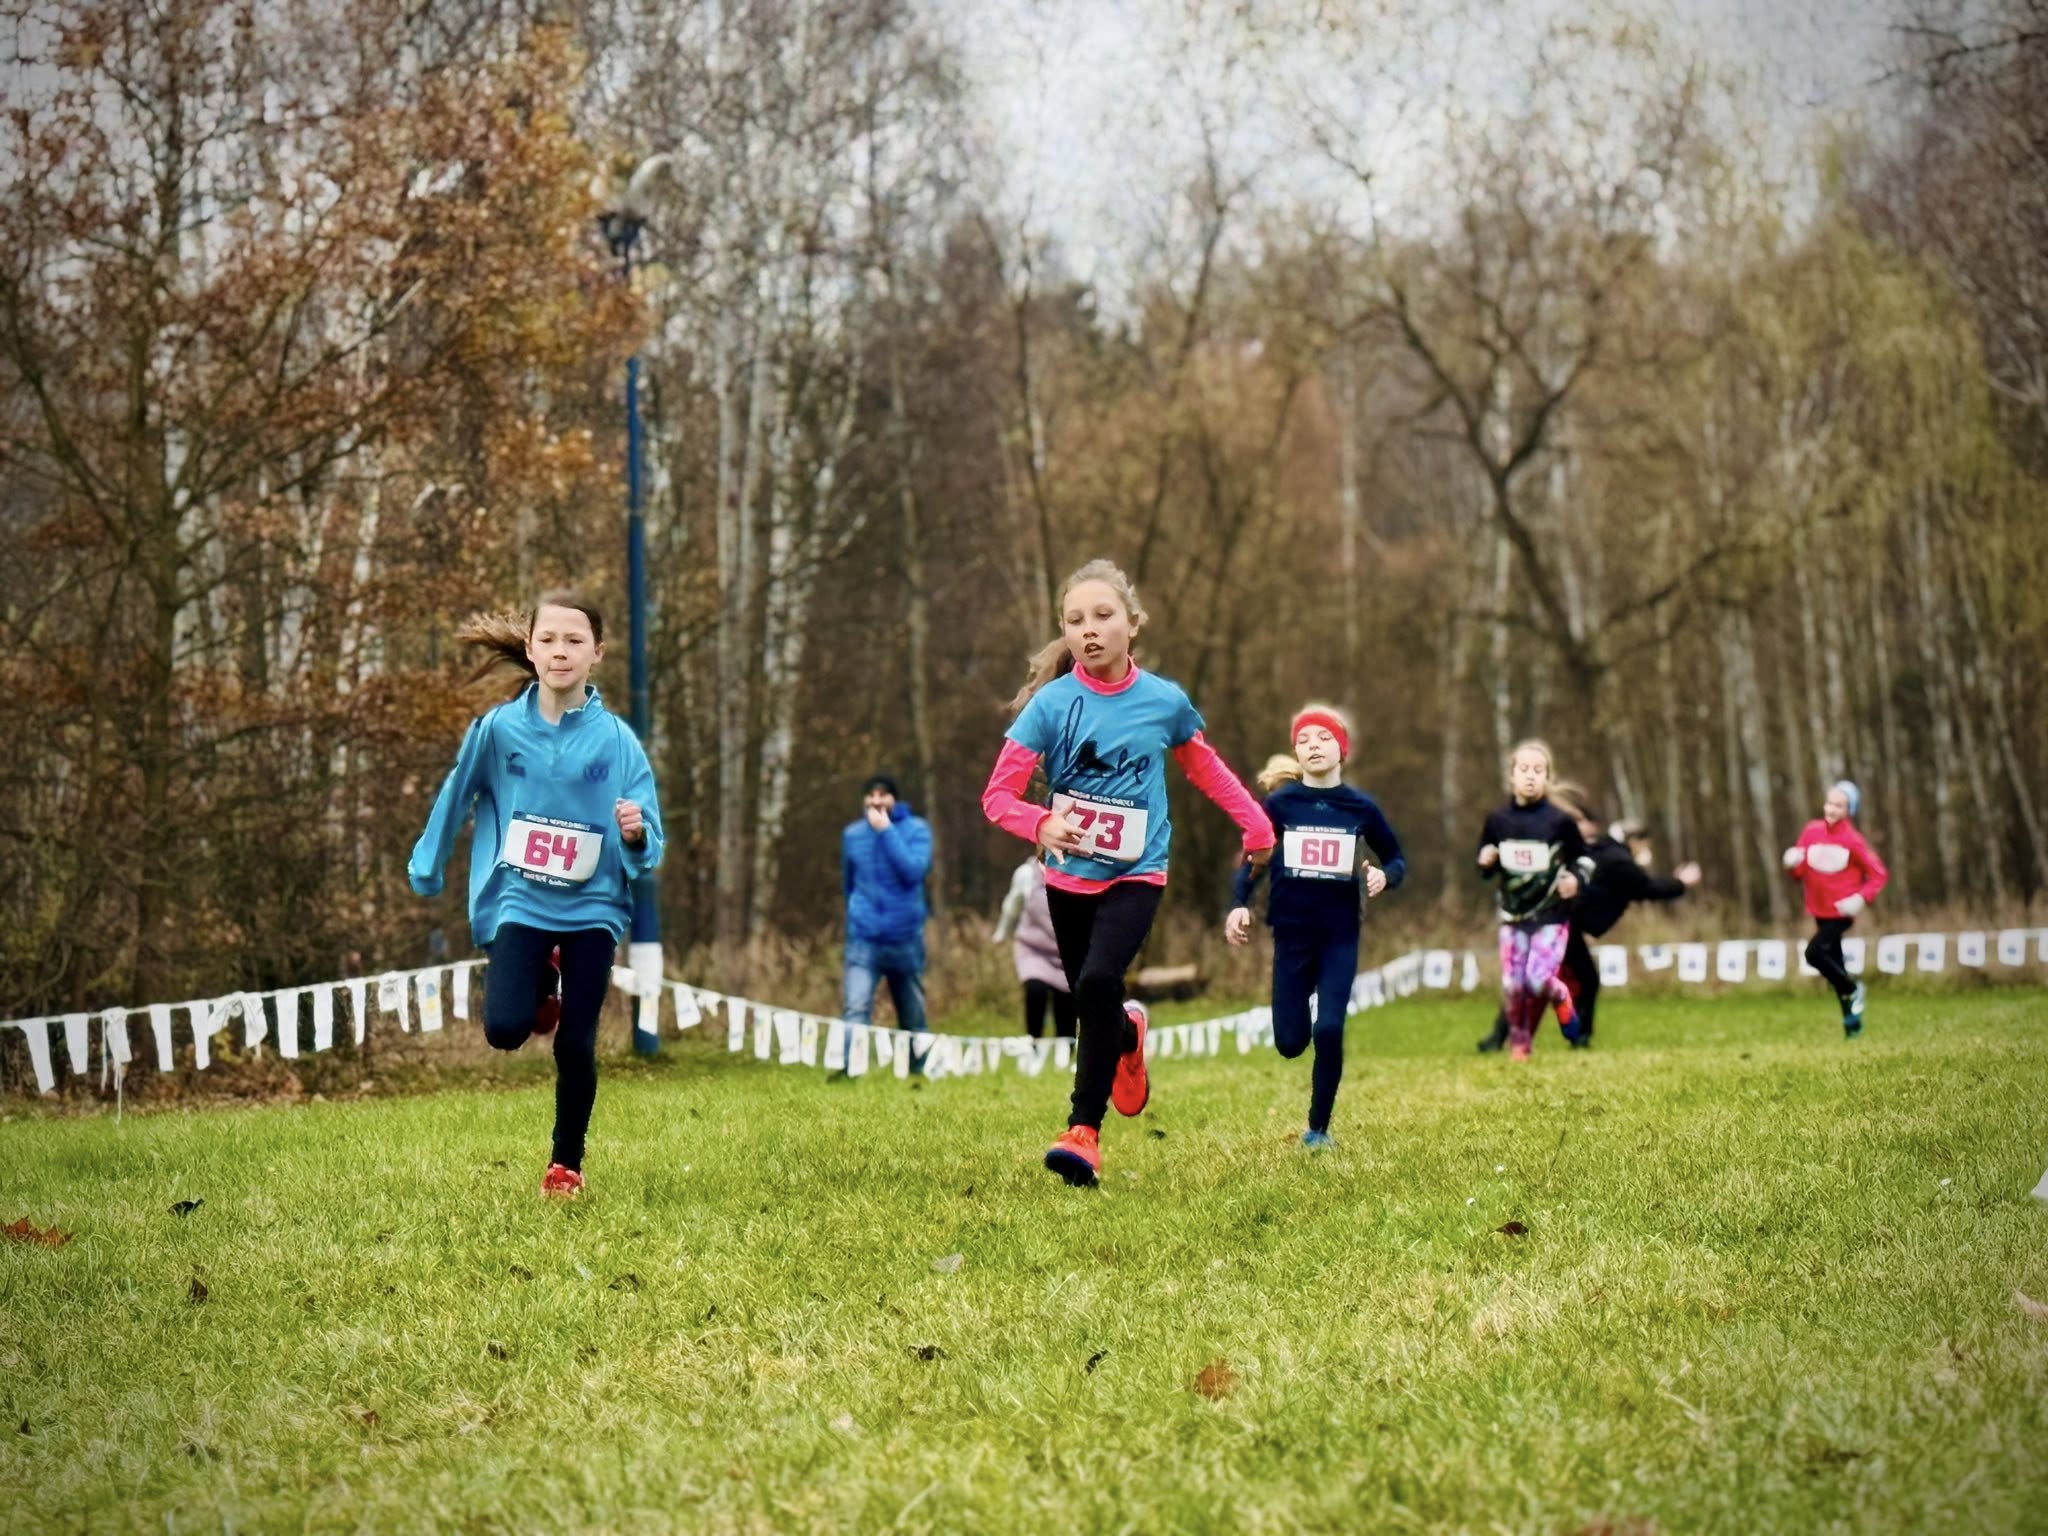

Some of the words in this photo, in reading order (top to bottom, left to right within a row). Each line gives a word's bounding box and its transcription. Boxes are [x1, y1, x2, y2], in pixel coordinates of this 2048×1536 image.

[1072, 805, 1125, 851] 73
[524, 829, 578, 872] 64
[1301, 838, 1340, 867] 60
